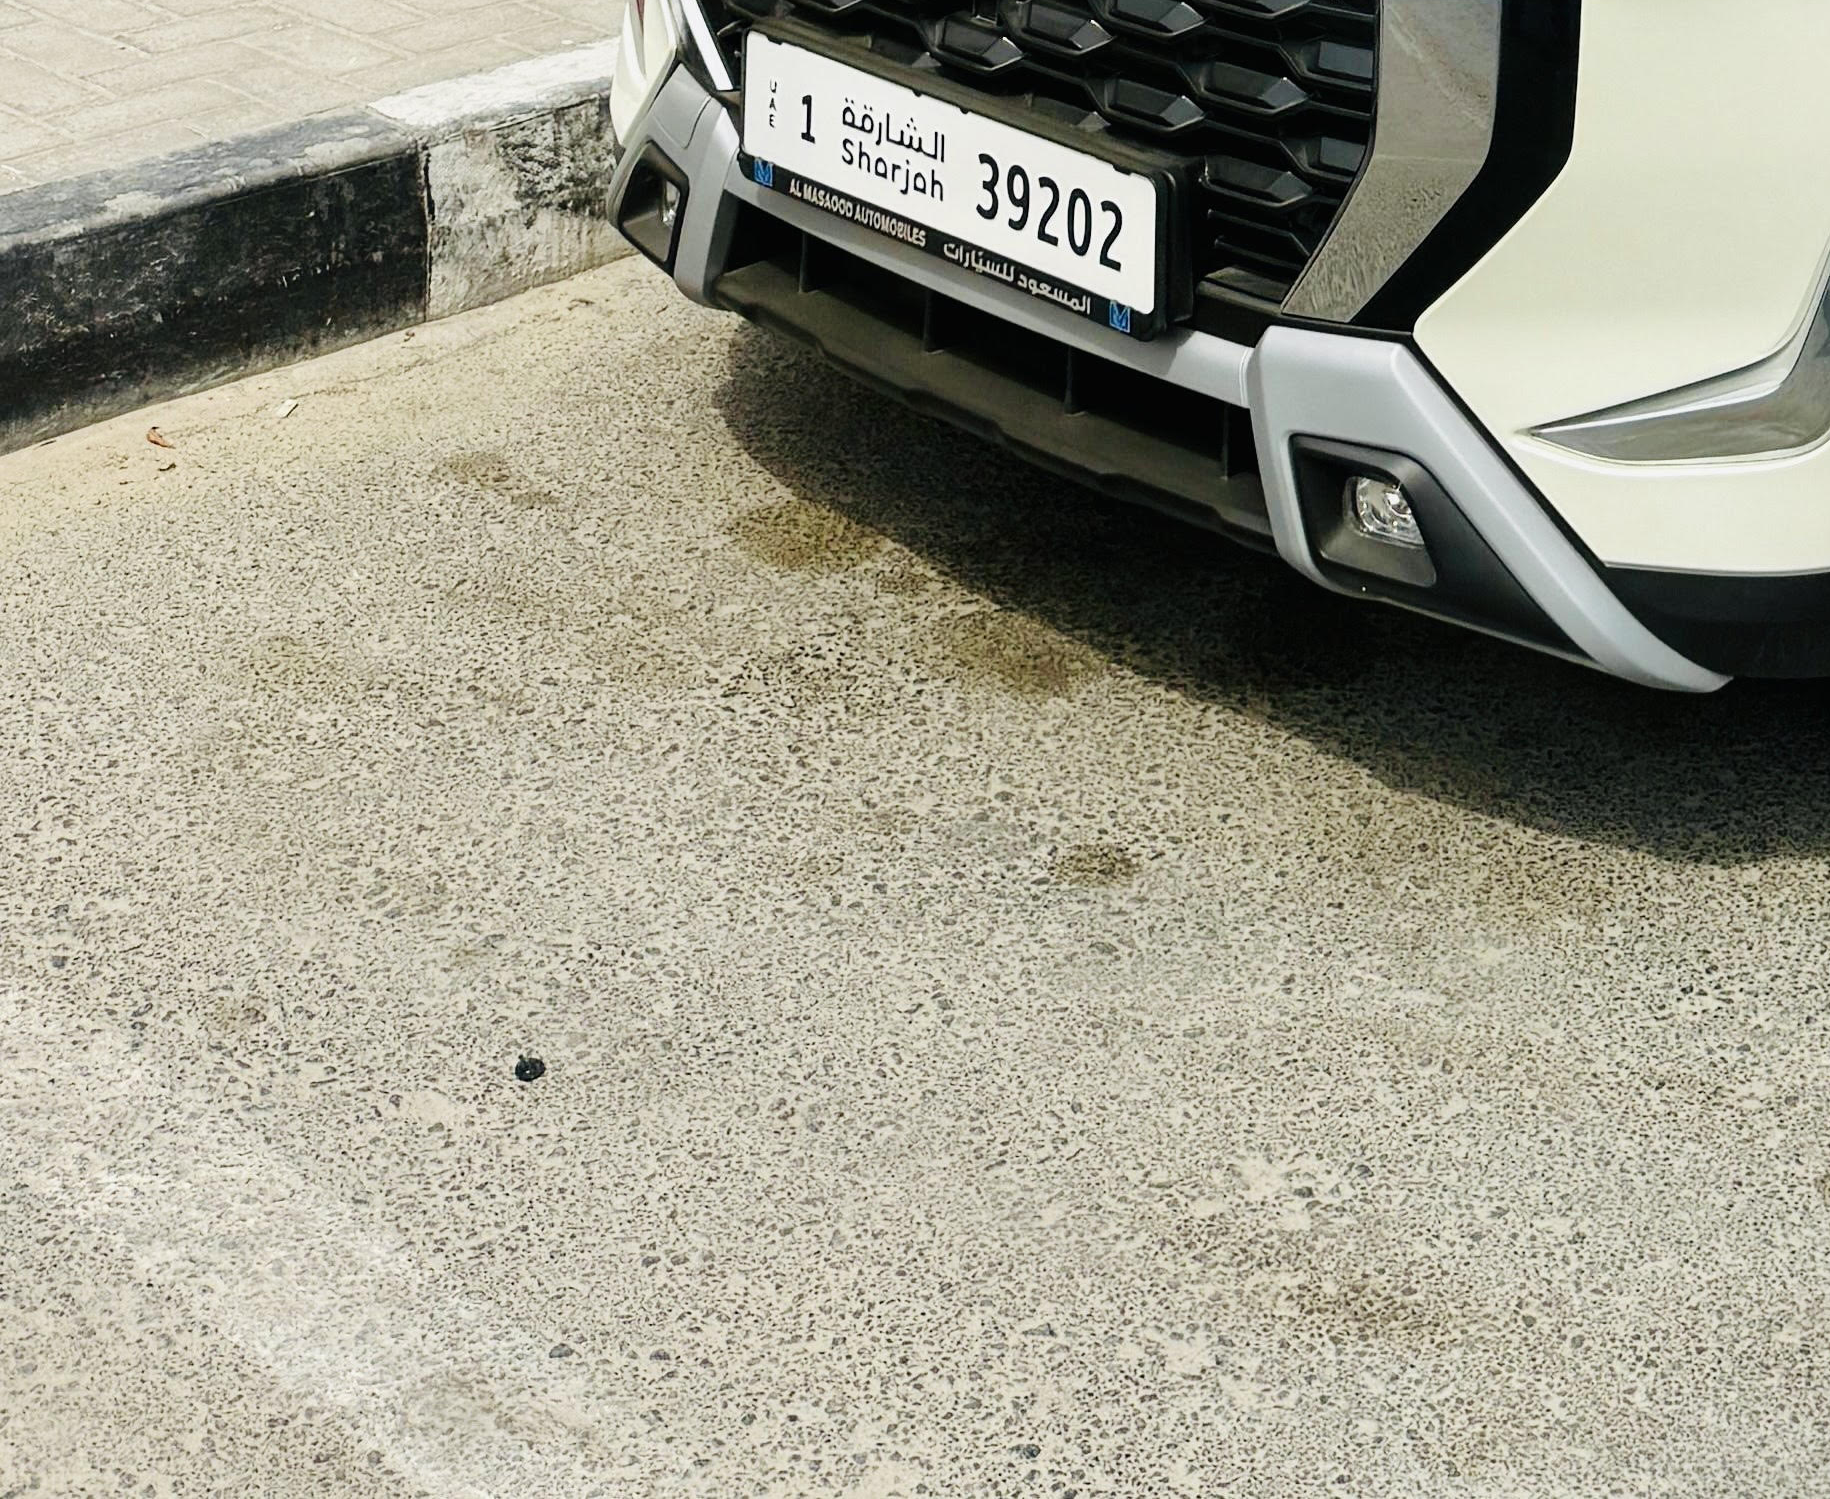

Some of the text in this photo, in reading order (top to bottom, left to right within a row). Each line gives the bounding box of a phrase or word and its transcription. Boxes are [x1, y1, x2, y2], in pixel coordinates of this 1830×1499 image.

[801, 94, 816, 144] 1
[842, 97, 945, 163] الشارقة
[842, 138, 944, 202] Sharjah
[789, 178, 927, 248] AL MASAOOD AUTOMOBILES
[976, 153, 1123, 273] 39202
[1017, 274, 1092, 315] المسعود
